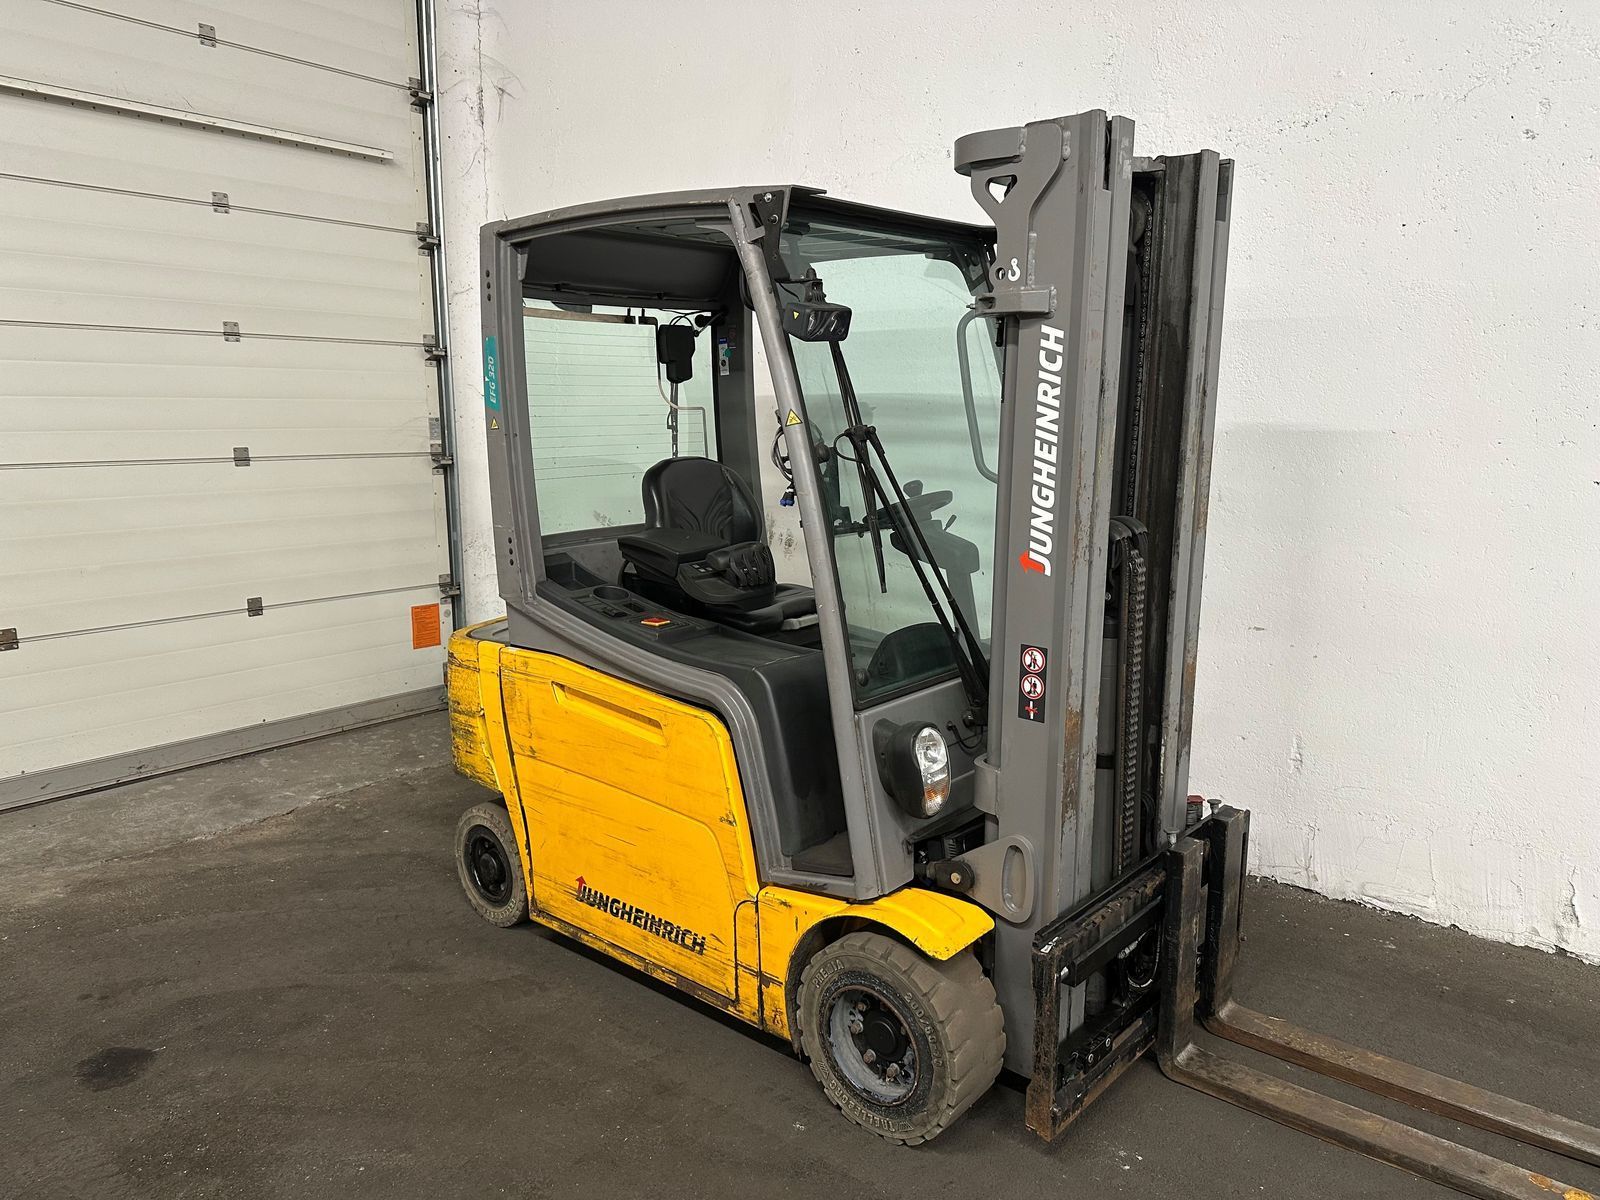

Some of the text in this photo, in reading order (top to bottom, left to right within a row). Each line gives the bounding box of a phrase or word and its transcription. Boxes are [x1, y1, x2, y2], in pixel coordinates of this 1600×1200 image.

[487, 355, 497, 404] EFG 320
[1019, 324, 1065, 576] JUNGHEINRICH
[575, 876, 706, 956] JUNGHEINRICH
